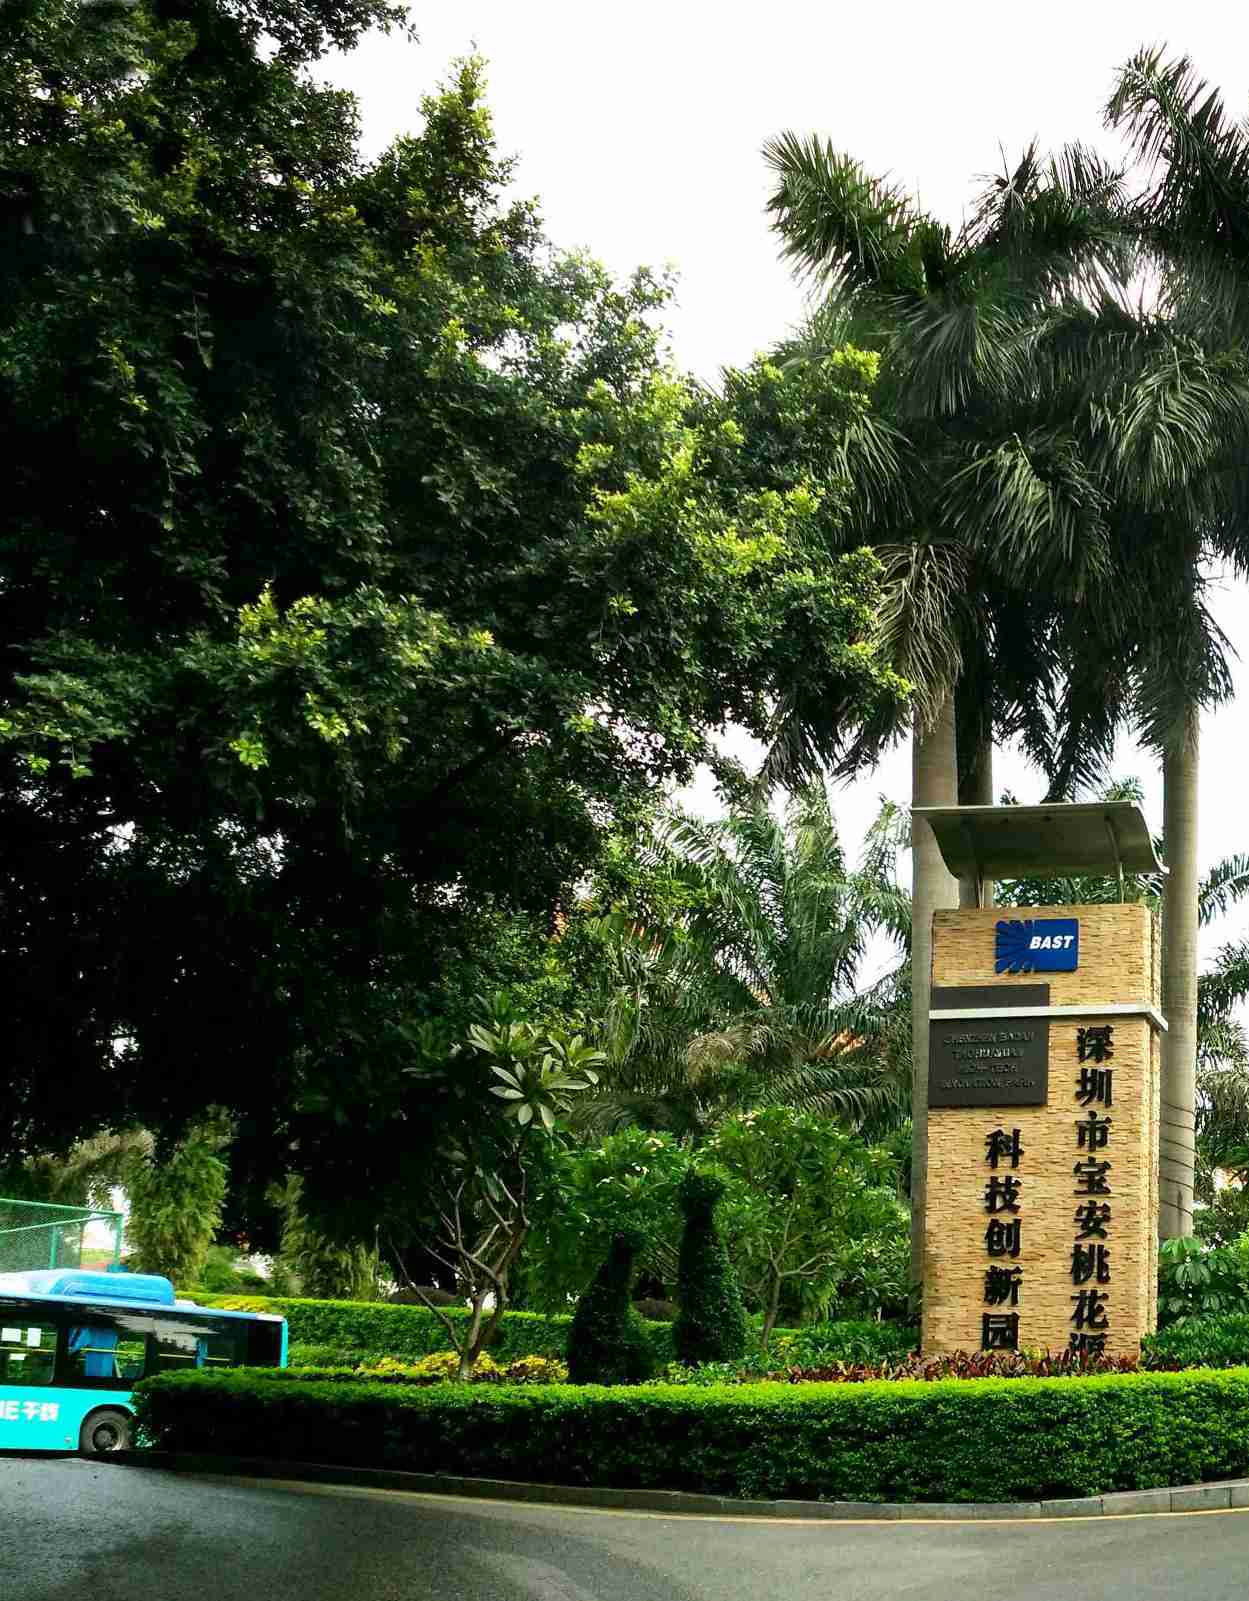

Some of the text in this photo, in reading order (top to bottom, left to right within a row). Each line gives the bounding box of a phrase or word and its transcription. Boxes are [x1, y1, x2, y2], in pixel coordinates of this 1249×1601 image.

[1029, 935, 1075, 951] BAST
[981, 1128, 1026, 1351] 科技创新园
[1069, 1025, 1115, 1356] 深圳市宝安桃花源
